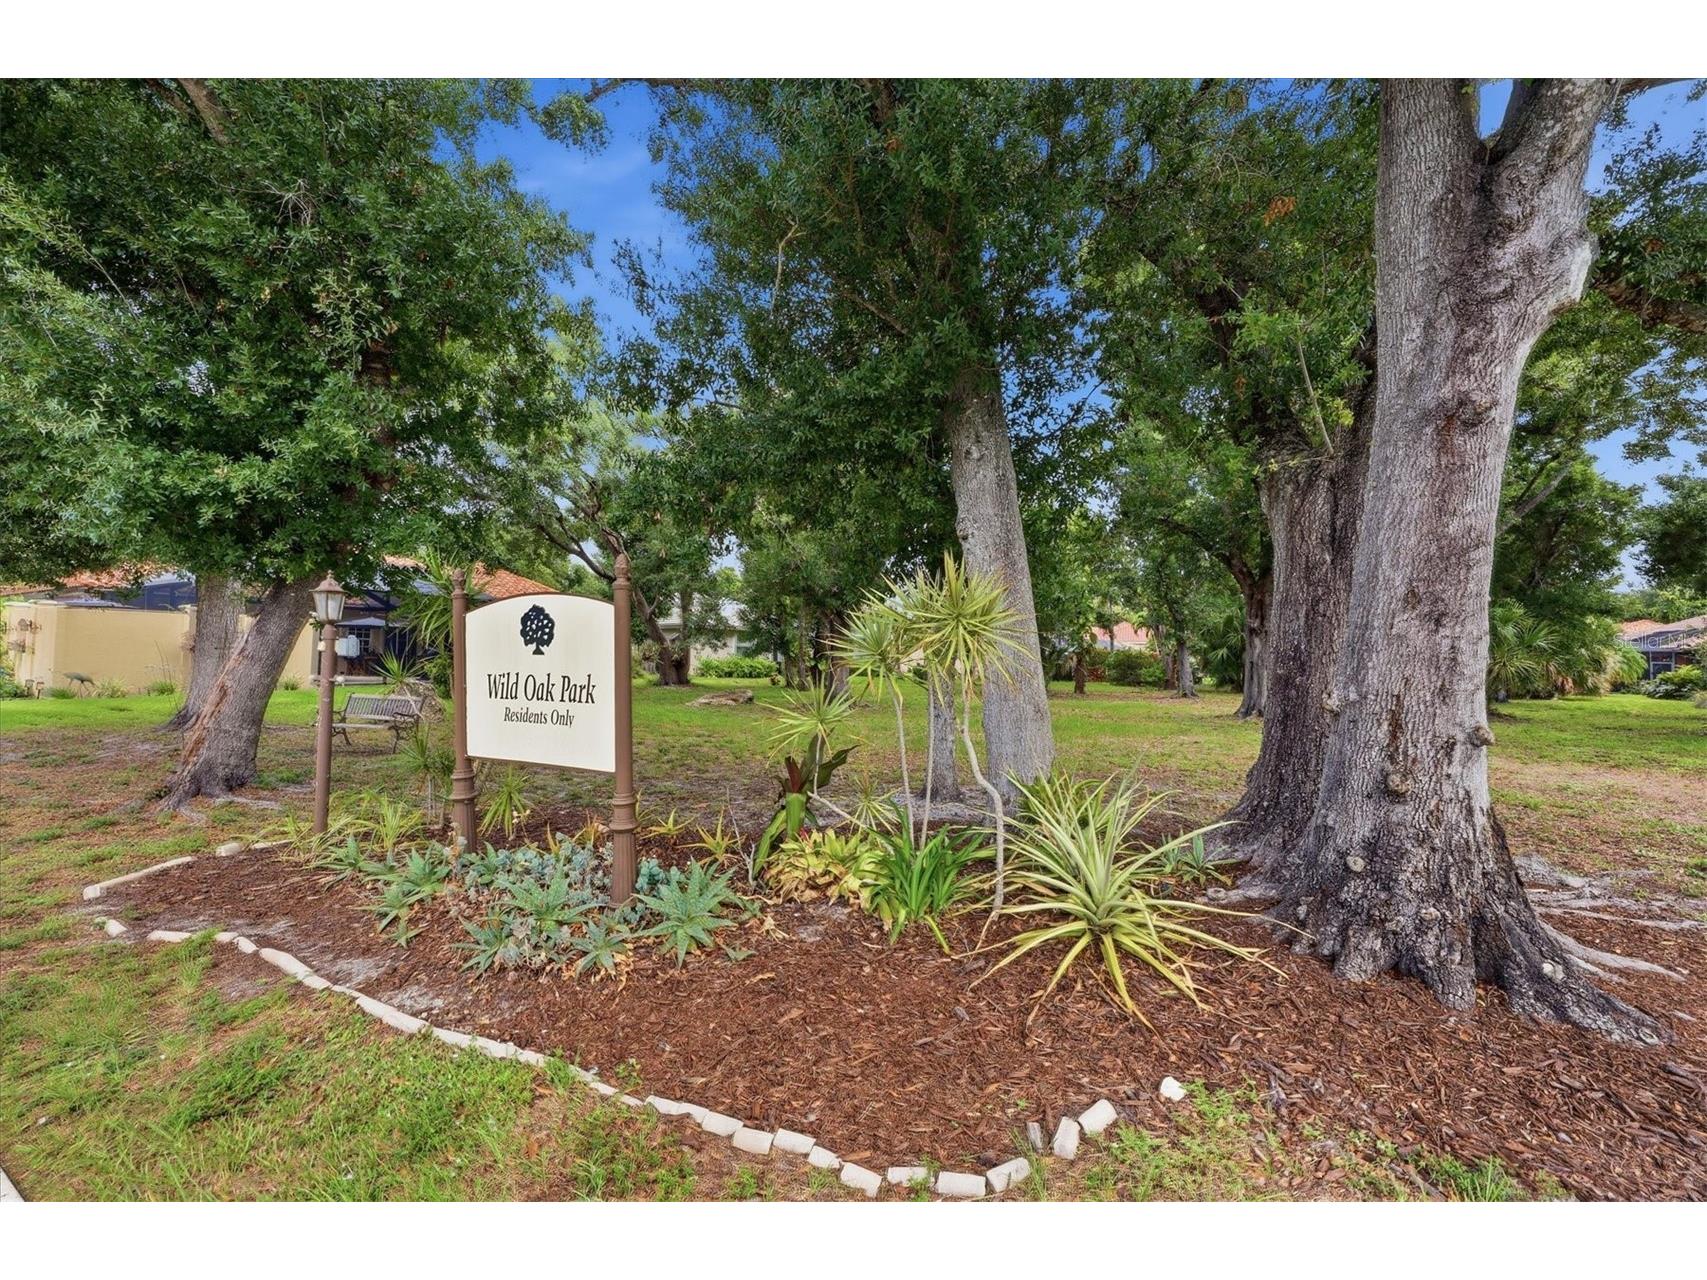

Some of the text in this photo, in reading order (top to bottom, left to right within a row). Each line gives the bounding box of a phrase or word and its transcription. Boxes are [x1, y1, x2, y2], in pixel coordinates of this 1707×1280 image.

[487, 671, 597, 704] Wild Oak Park
[503, 706, 575, 728] Residents Only
